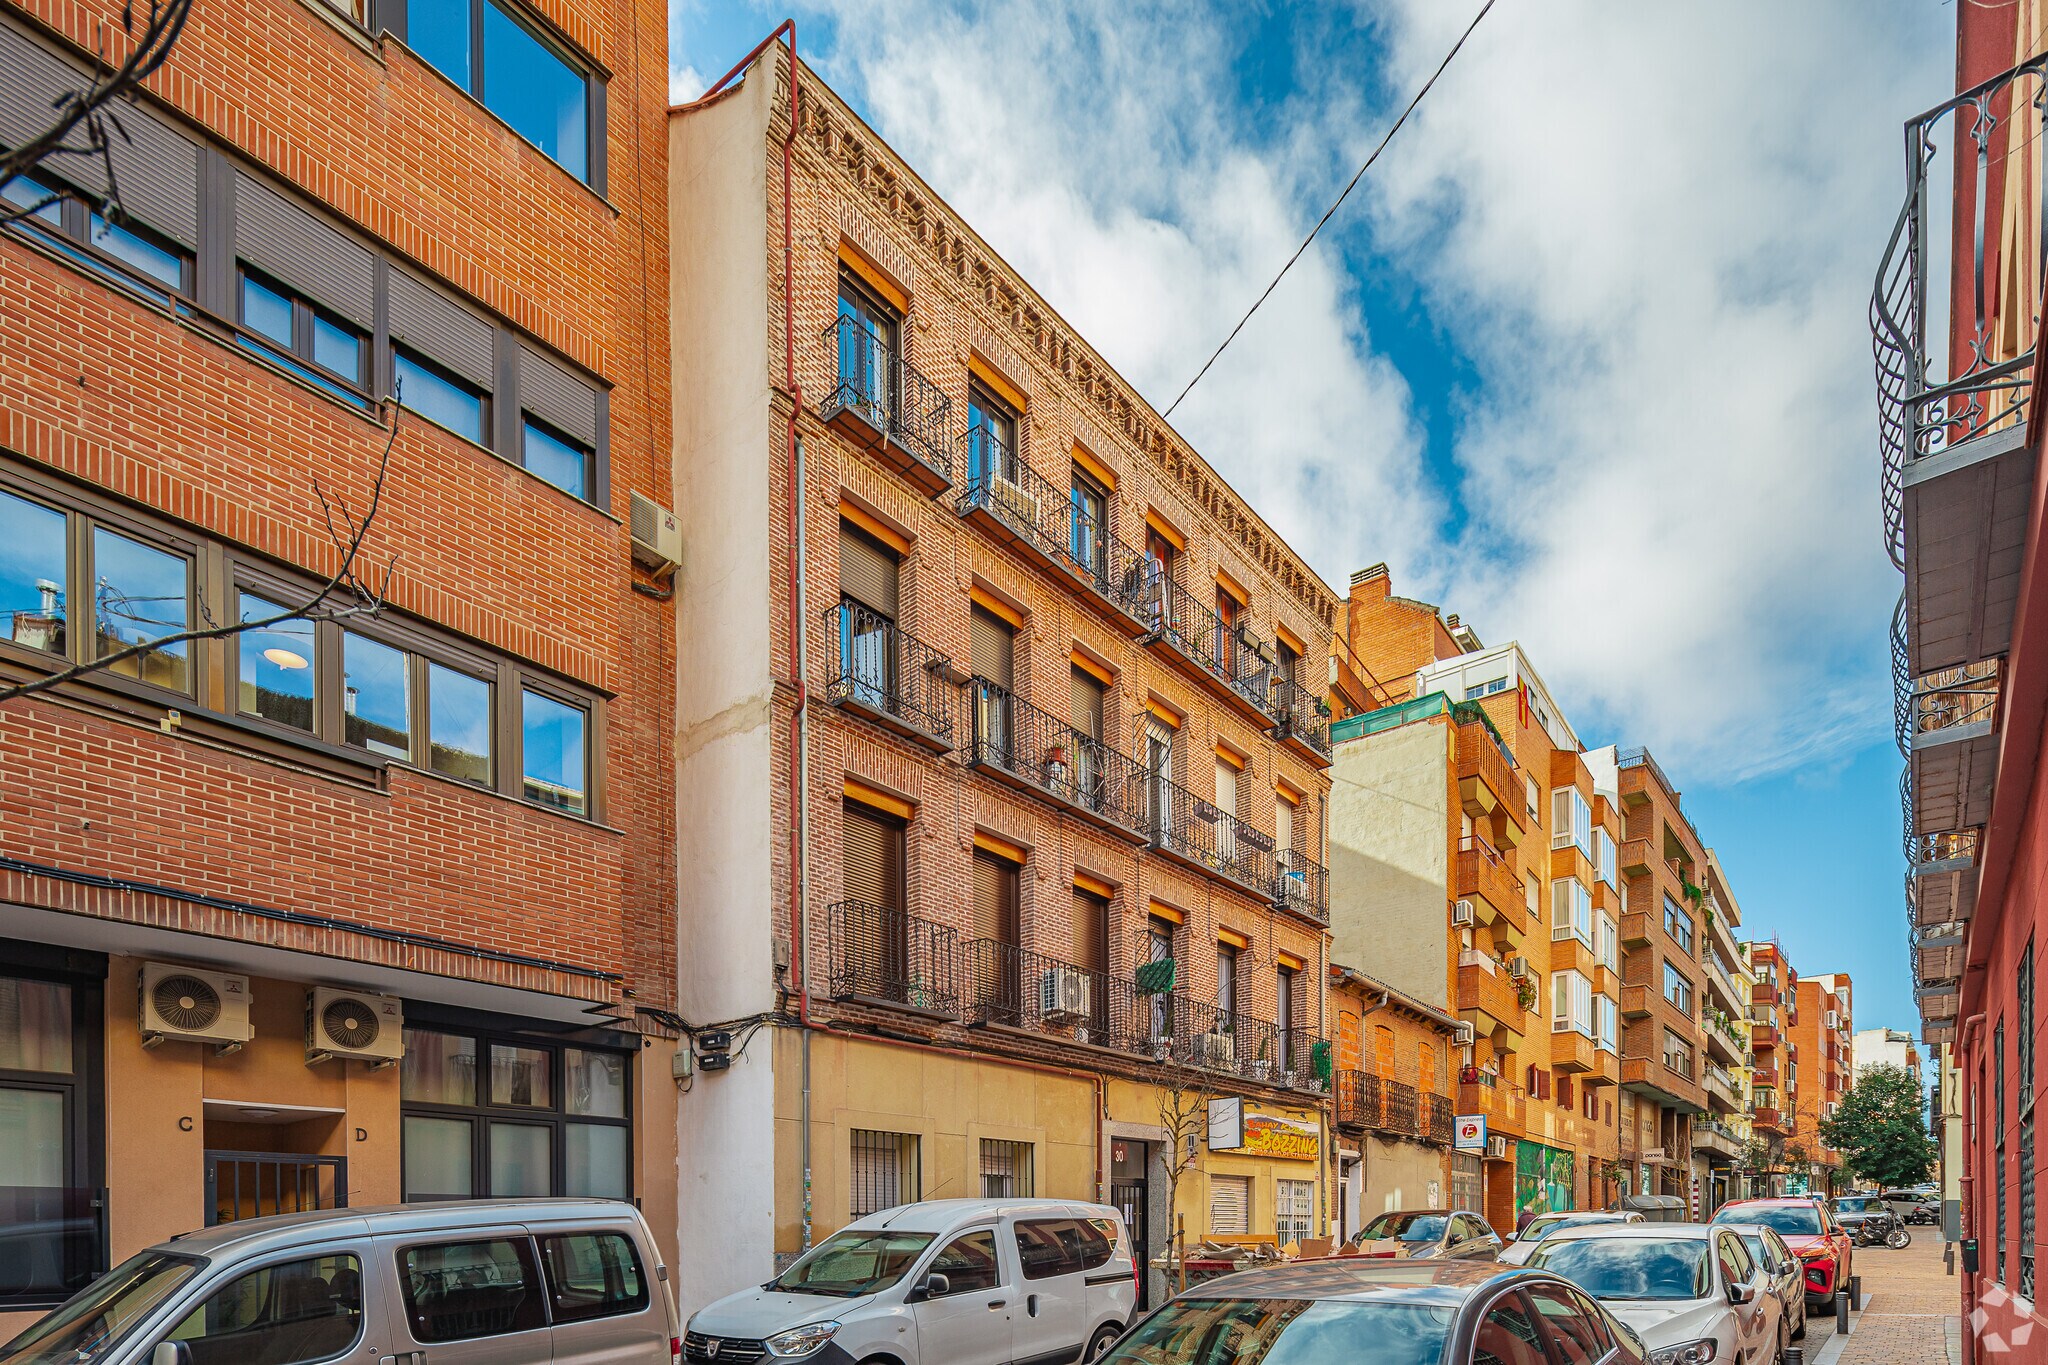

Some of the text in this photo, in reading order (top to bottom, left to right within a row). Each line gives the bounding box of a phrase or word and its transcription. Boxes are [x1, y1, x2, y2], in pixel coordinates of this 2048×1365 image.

[178, 1116, 193, 1132] C
[1247, 1119, 1279, 1129] BAHAY
[355, 1128, 368, 1142] D
[1465, 1125, 1474, 1137] E
[1260, 1128, 1318, 1155] BOZZING
[1115, 1151, 1123, 1162] 30
[1282, 1150, 1319, 1160] RESTAURANT
